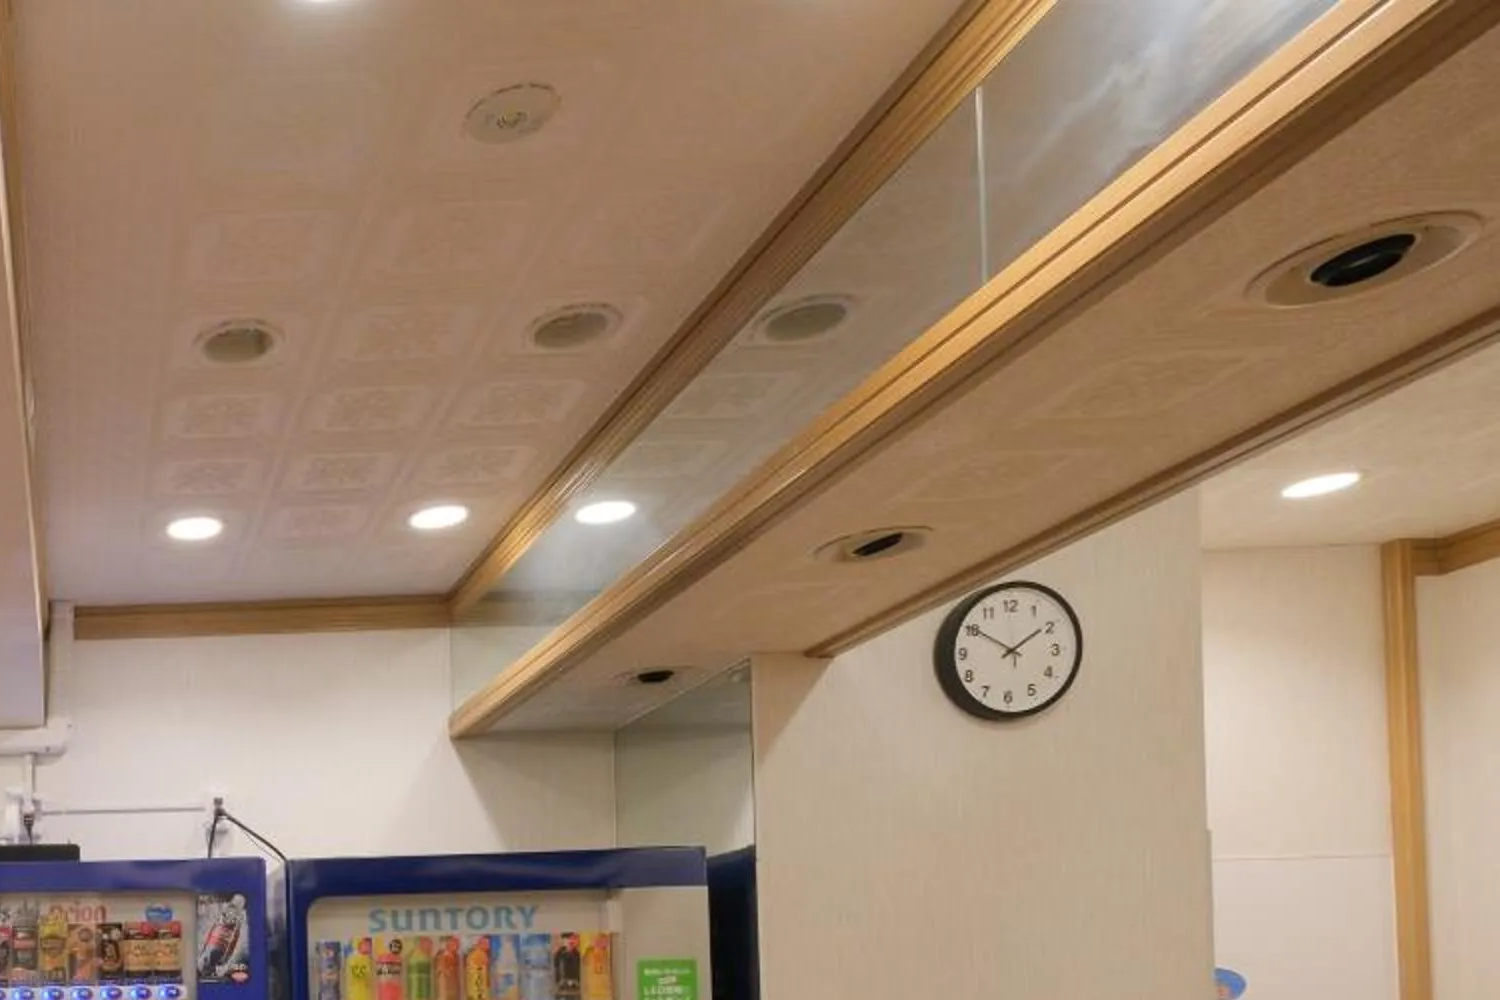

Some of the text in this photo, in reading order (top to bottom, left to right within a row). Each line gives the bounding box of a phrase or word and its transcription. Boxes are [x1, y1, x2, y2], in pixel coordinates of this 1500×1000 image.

[1003, 599, 1019, 613] 12
[1031, 605, 1038, 618] 1
[983, 607, 995, 620] 11
[966, 623, 980, 637] 10
[1045, 621, 1055, 634] 2
[958, 648, 967, 660] 9
[1051, 643, 1061, 656] 3
[964, 670, 974, 683] 8
[1043, 666, 1053, 678] 4
[981, 685, 990, 698] 7
[1027, 683, 1037, 696] 5
[1003, 690, 1013, 704] 6
